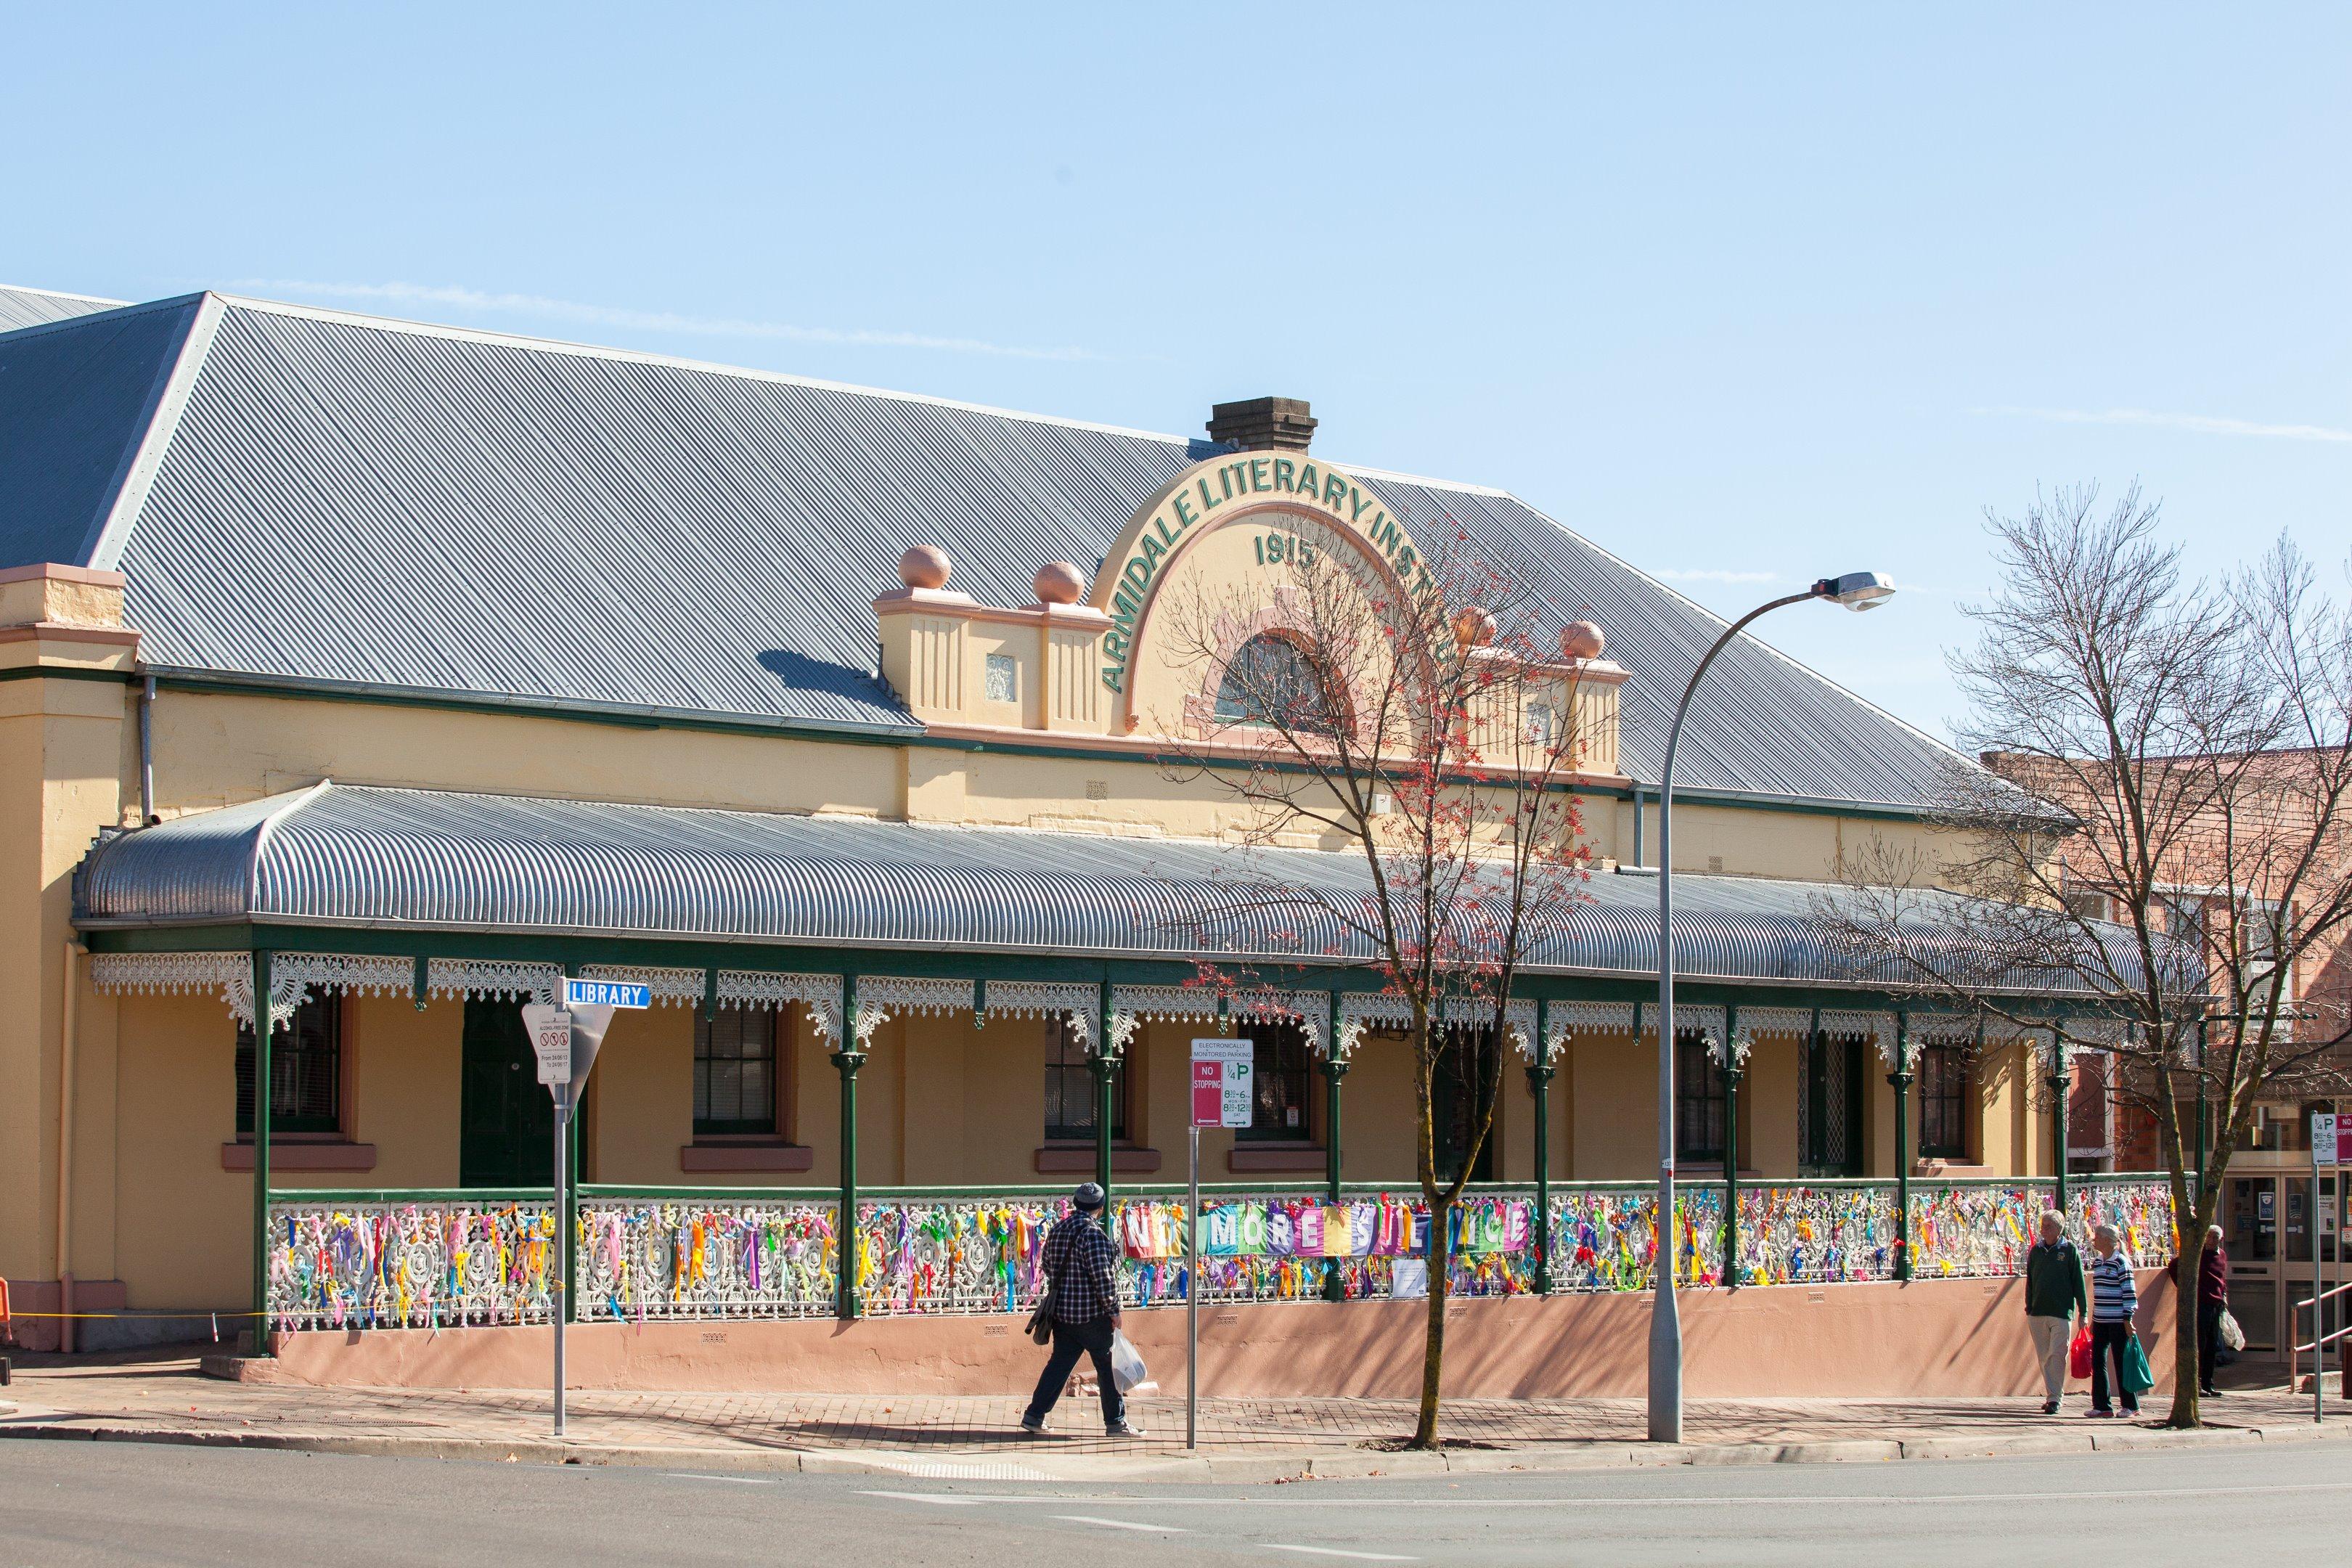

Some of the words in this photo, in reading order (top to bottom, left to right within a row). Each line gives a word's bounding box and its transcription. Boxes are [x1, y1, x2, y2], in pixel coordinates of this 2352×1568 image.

[1256, 534, 1316, 569] 1915
[1101, 489, 1200, 694] ARMIDALE
[1197, 457, 1373, 522] LITERARY
[572, 982, 642, 1005] LIBRARY
[1194, 1079, 1221, 1089] STOPPING
[1202, 1066, 1213, 1075] NO
[1210, 1213, 1318, 1248] MORE
